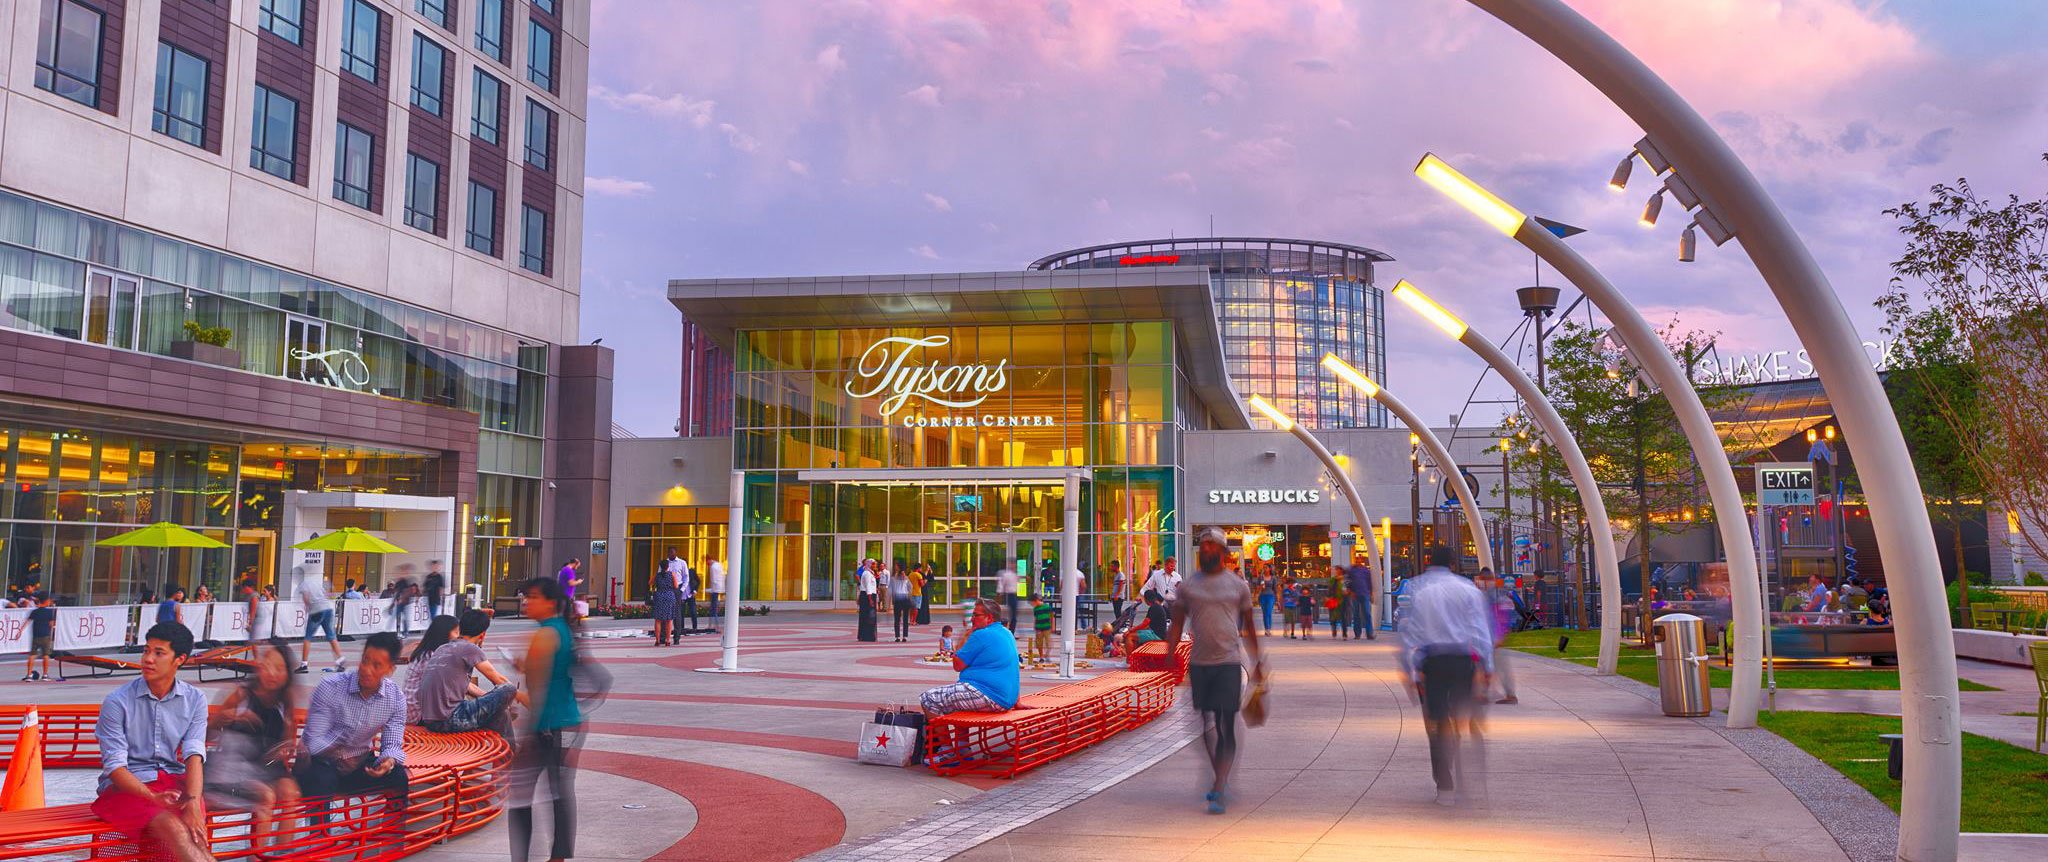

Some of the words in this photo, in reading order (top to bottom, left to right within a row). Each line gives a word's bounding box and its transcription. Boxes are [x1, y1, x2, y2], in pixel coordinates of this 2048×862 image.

[845, 335, 1007, 417] Tysons
[1699, 350, 1792, 386] SHAKE
[903, 415, 976, 428] CORNER
[982, 414, 1055, 427] CENTER
[1765, 471, 1801, 488] EXIT
[1209, 489, 1320, 503] STARBUCKS
